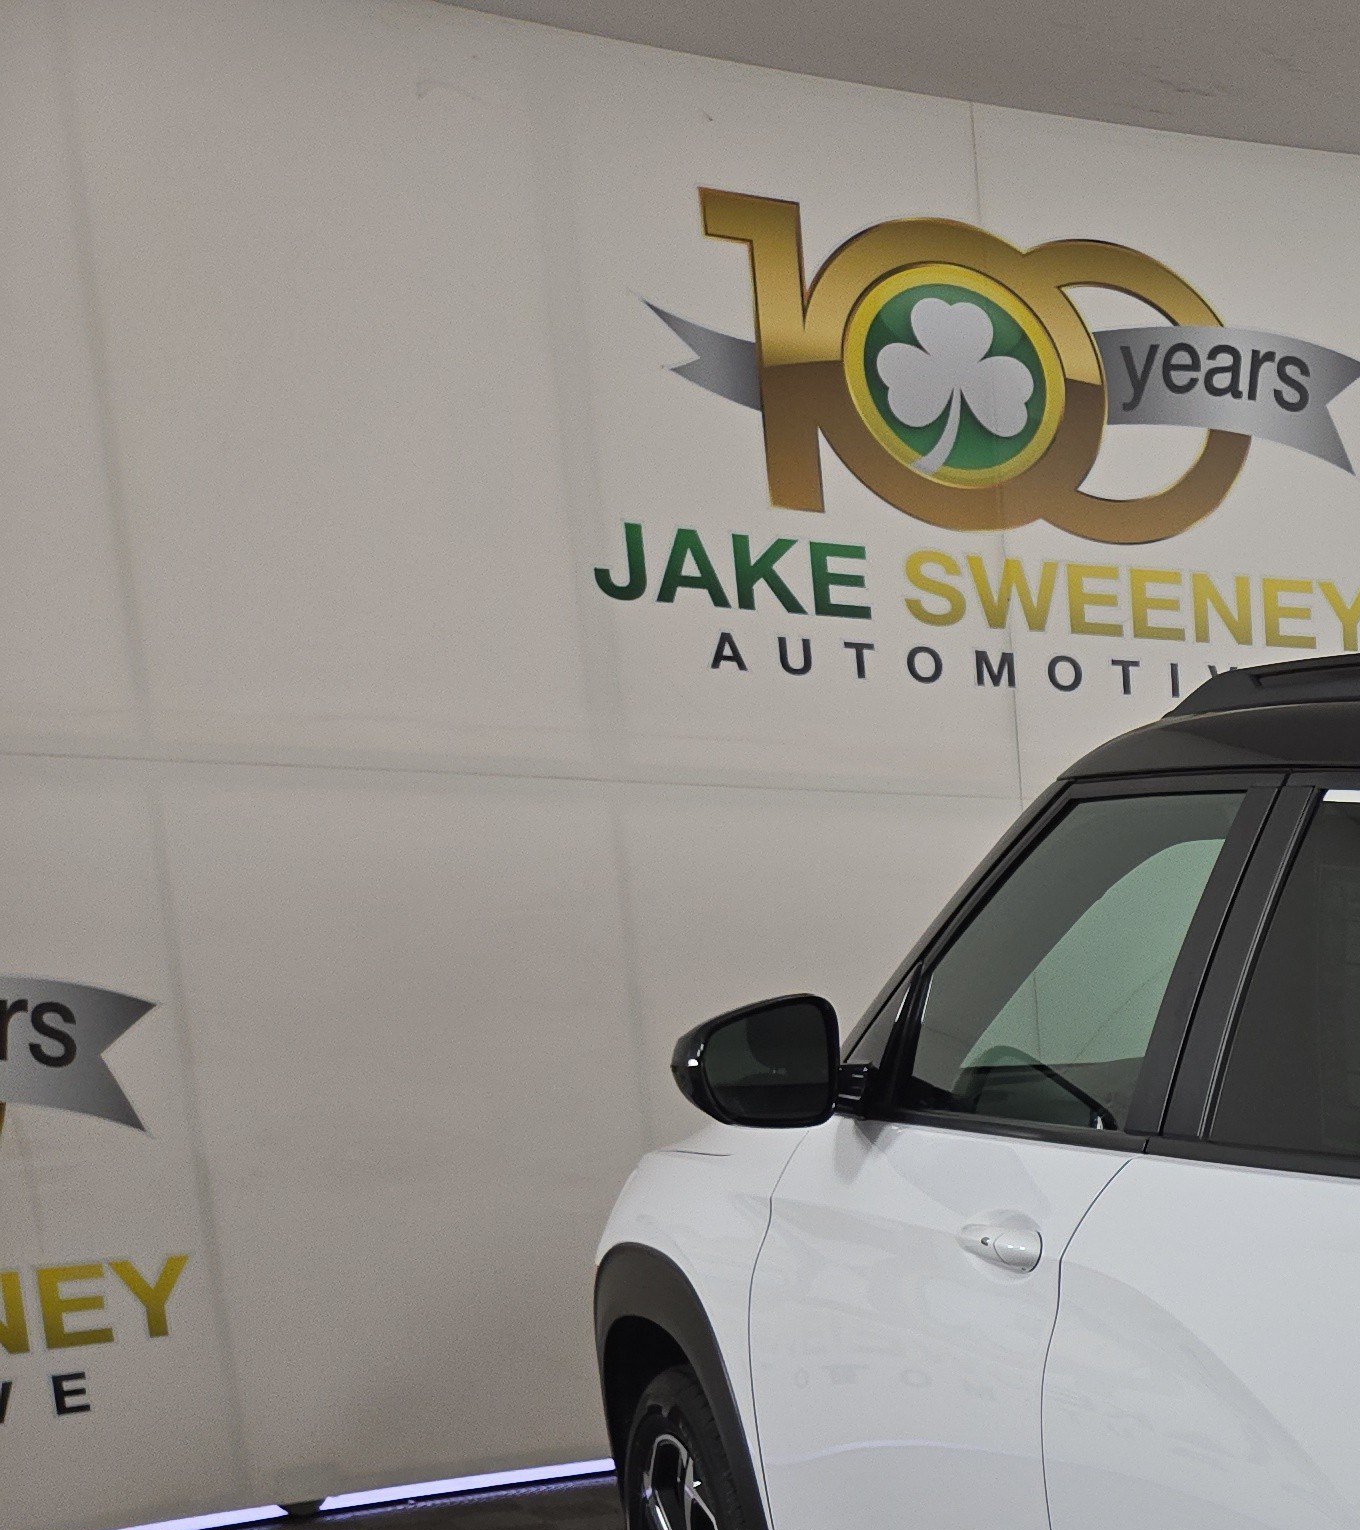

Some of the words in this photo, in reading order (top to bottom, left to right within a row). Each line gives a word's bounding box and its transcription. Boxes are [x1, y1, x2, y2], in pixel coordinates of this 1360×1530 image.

[1119, 341, 1312, 412] years
[594, 522, 873, 620] JAKE
[710, 632, 1238, 698] AUTOMOTI
